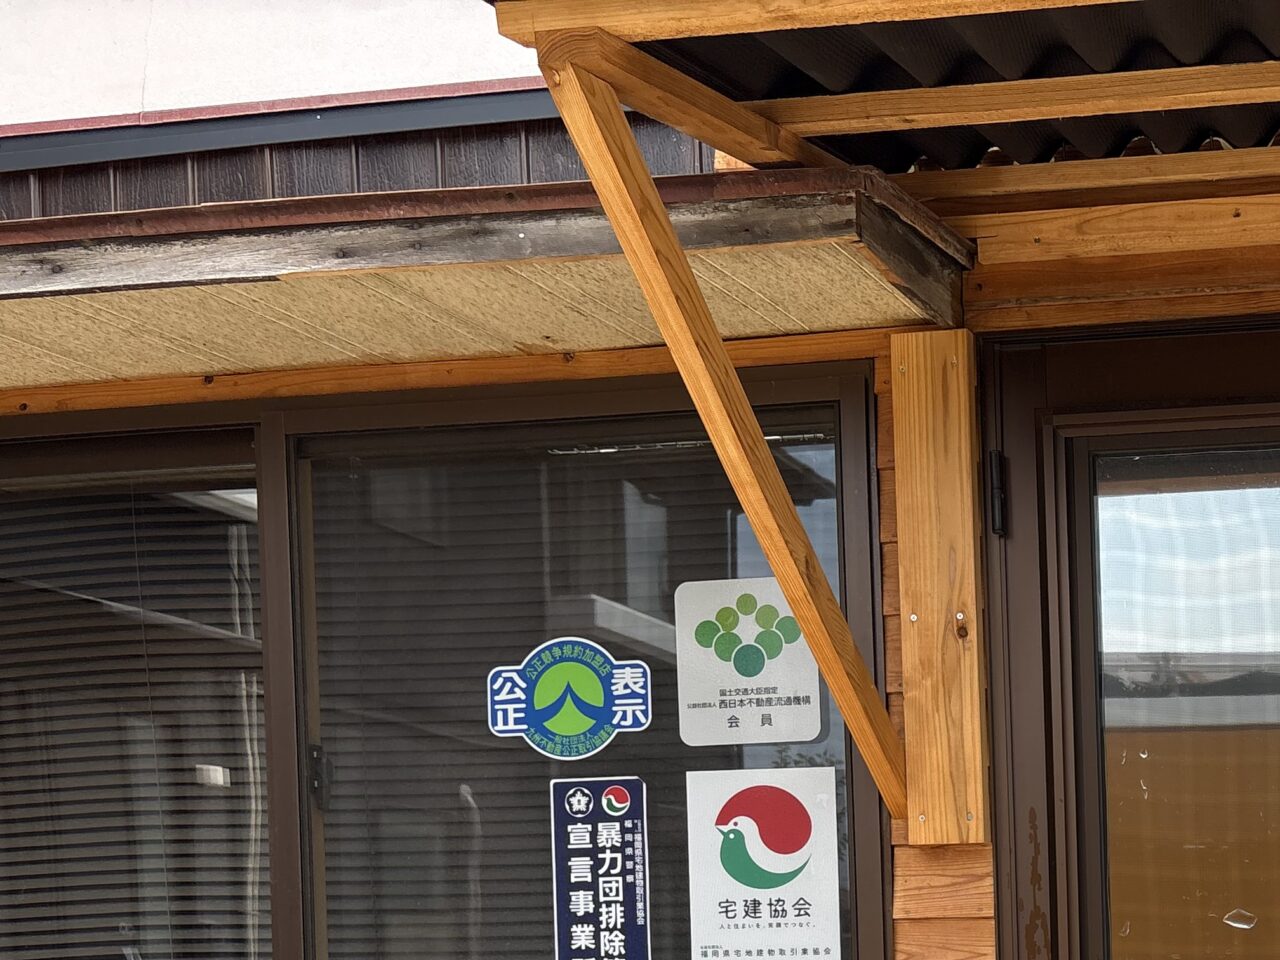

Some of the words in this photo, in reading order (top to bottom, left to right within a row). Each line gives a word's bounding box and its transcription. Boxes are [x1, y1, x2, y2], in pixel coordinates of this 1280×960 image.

[492, 671, 528, 731] 公正
[611, 666, 647, 726] 表示
[719, 686, 778, 697] 国土交通大臣指定
[718, 897, 812, 919] 宅建協会
[700, 947, 831, 958] 福岡県宅地建物取引業協会
